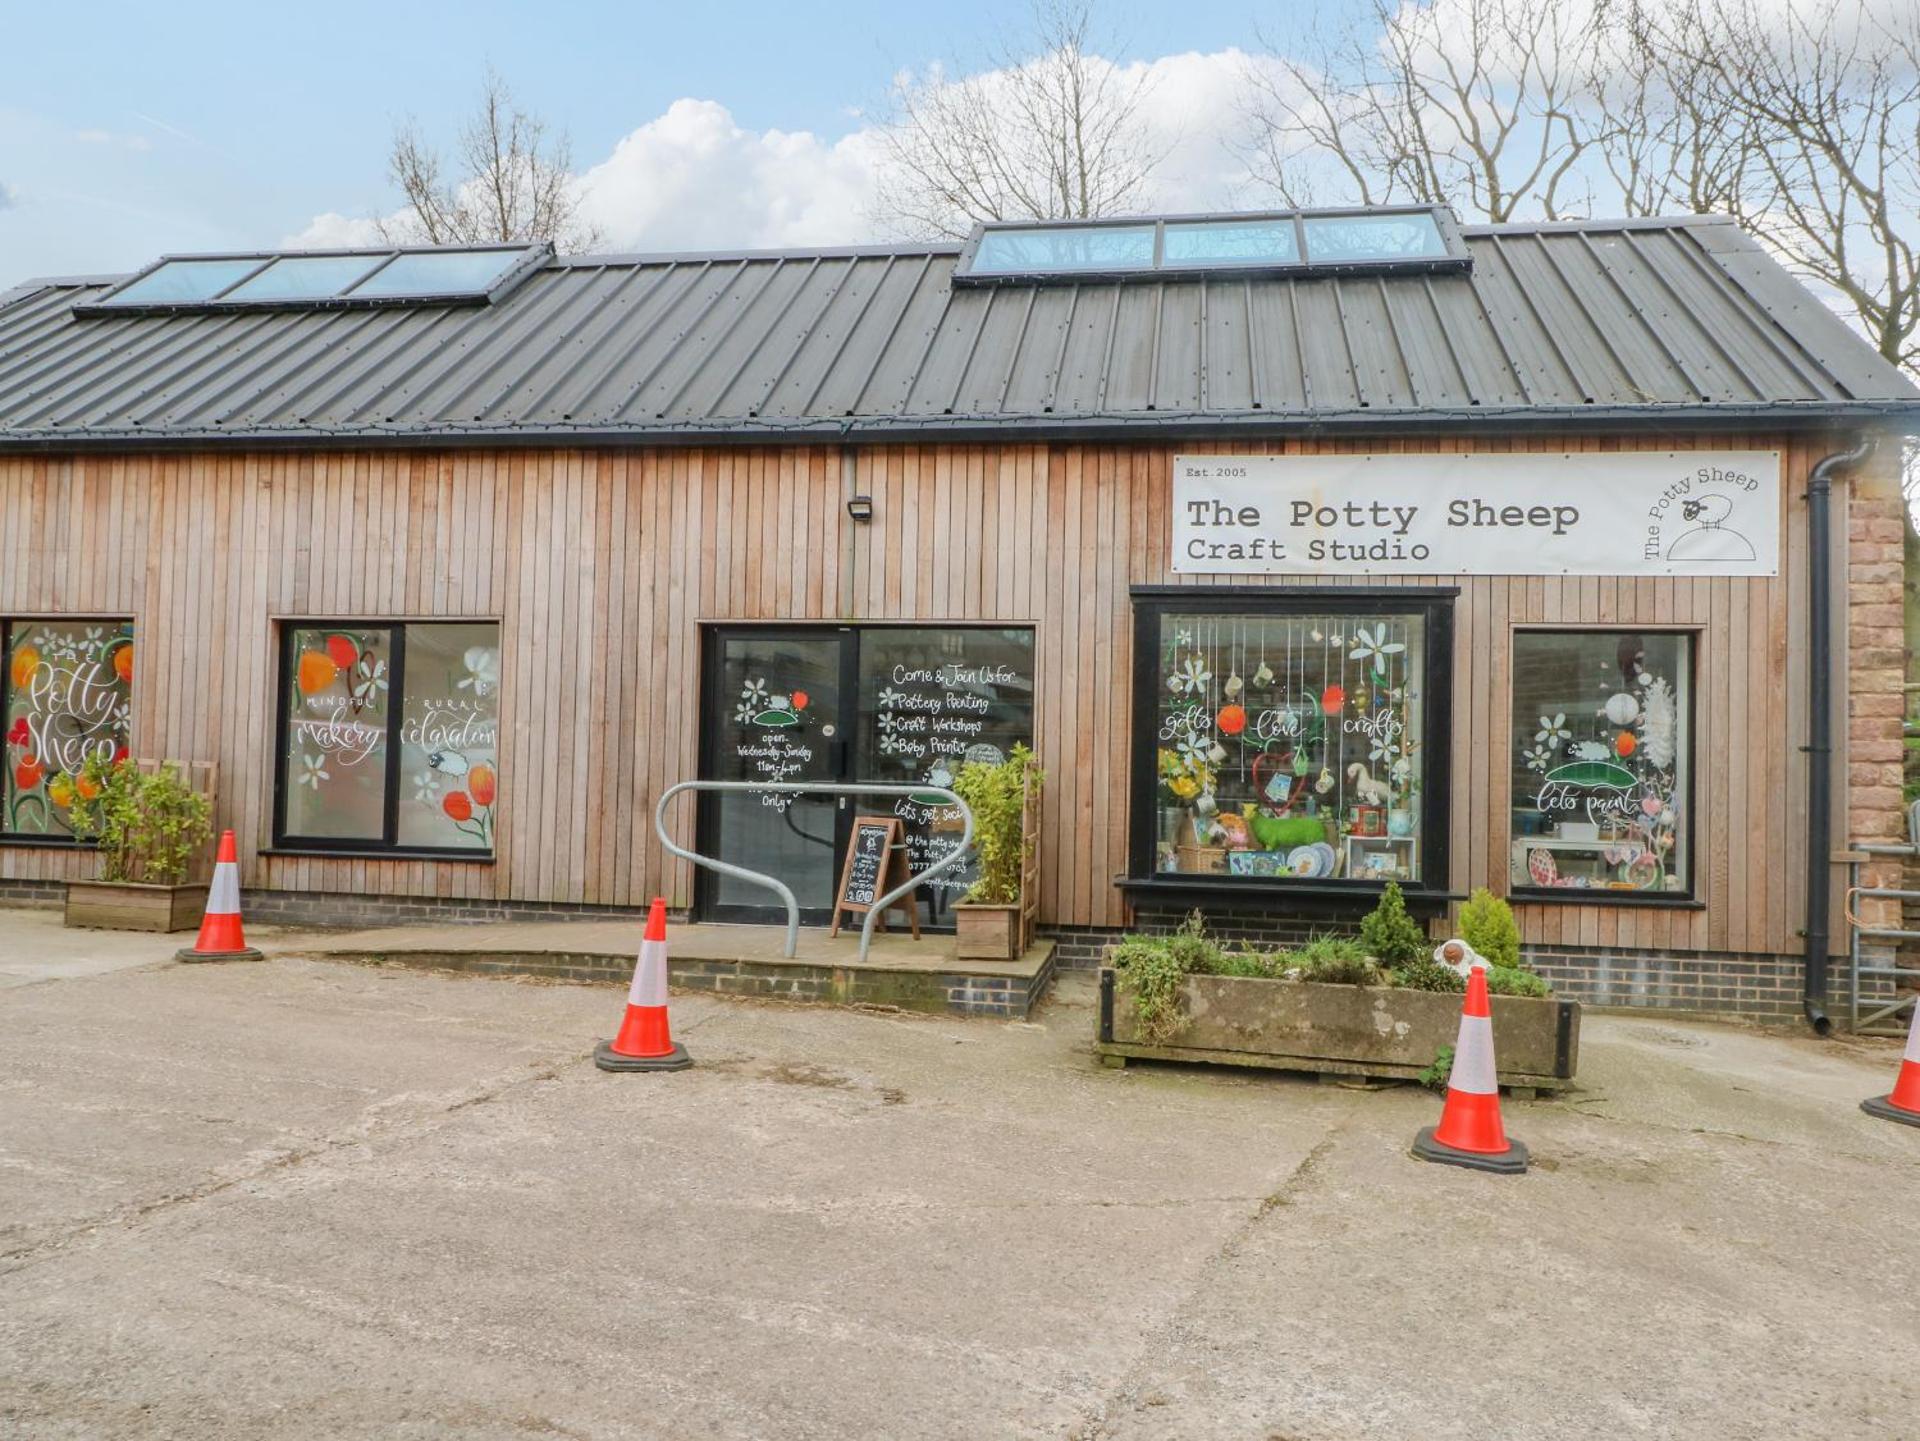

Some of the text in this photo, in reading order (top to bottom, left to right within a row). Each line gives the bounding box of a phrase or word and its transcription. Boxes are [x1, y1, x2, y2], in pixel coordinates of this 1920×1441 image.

[1188, 499, 1581, 535] The Potty Sheep
[1644, 467, 1759, 560] The Potty Sheep
[1187, 539, 1431, 561] Craft Studio
[893, 664, 933, 685] Come
[935, 671, 945, 683] &
[945, 664, 976, 687] Join
[979, 665, 994, 684] Us
[22, 661, 120, 737] Potty
[424, 699, 485, 711] RURAL
[897, 692, 989, 714] Pottery Painting
[896, 717, 983, 736] Craft Workshops
[1159, 705, 1403, 741] gifts love crafts
[17, 711, 117, 778] Sheep
[898, 736, 968, 758] Baby Prints
[918, 807, 939, 825] get
[1586, 785, 1640, 827] paint
